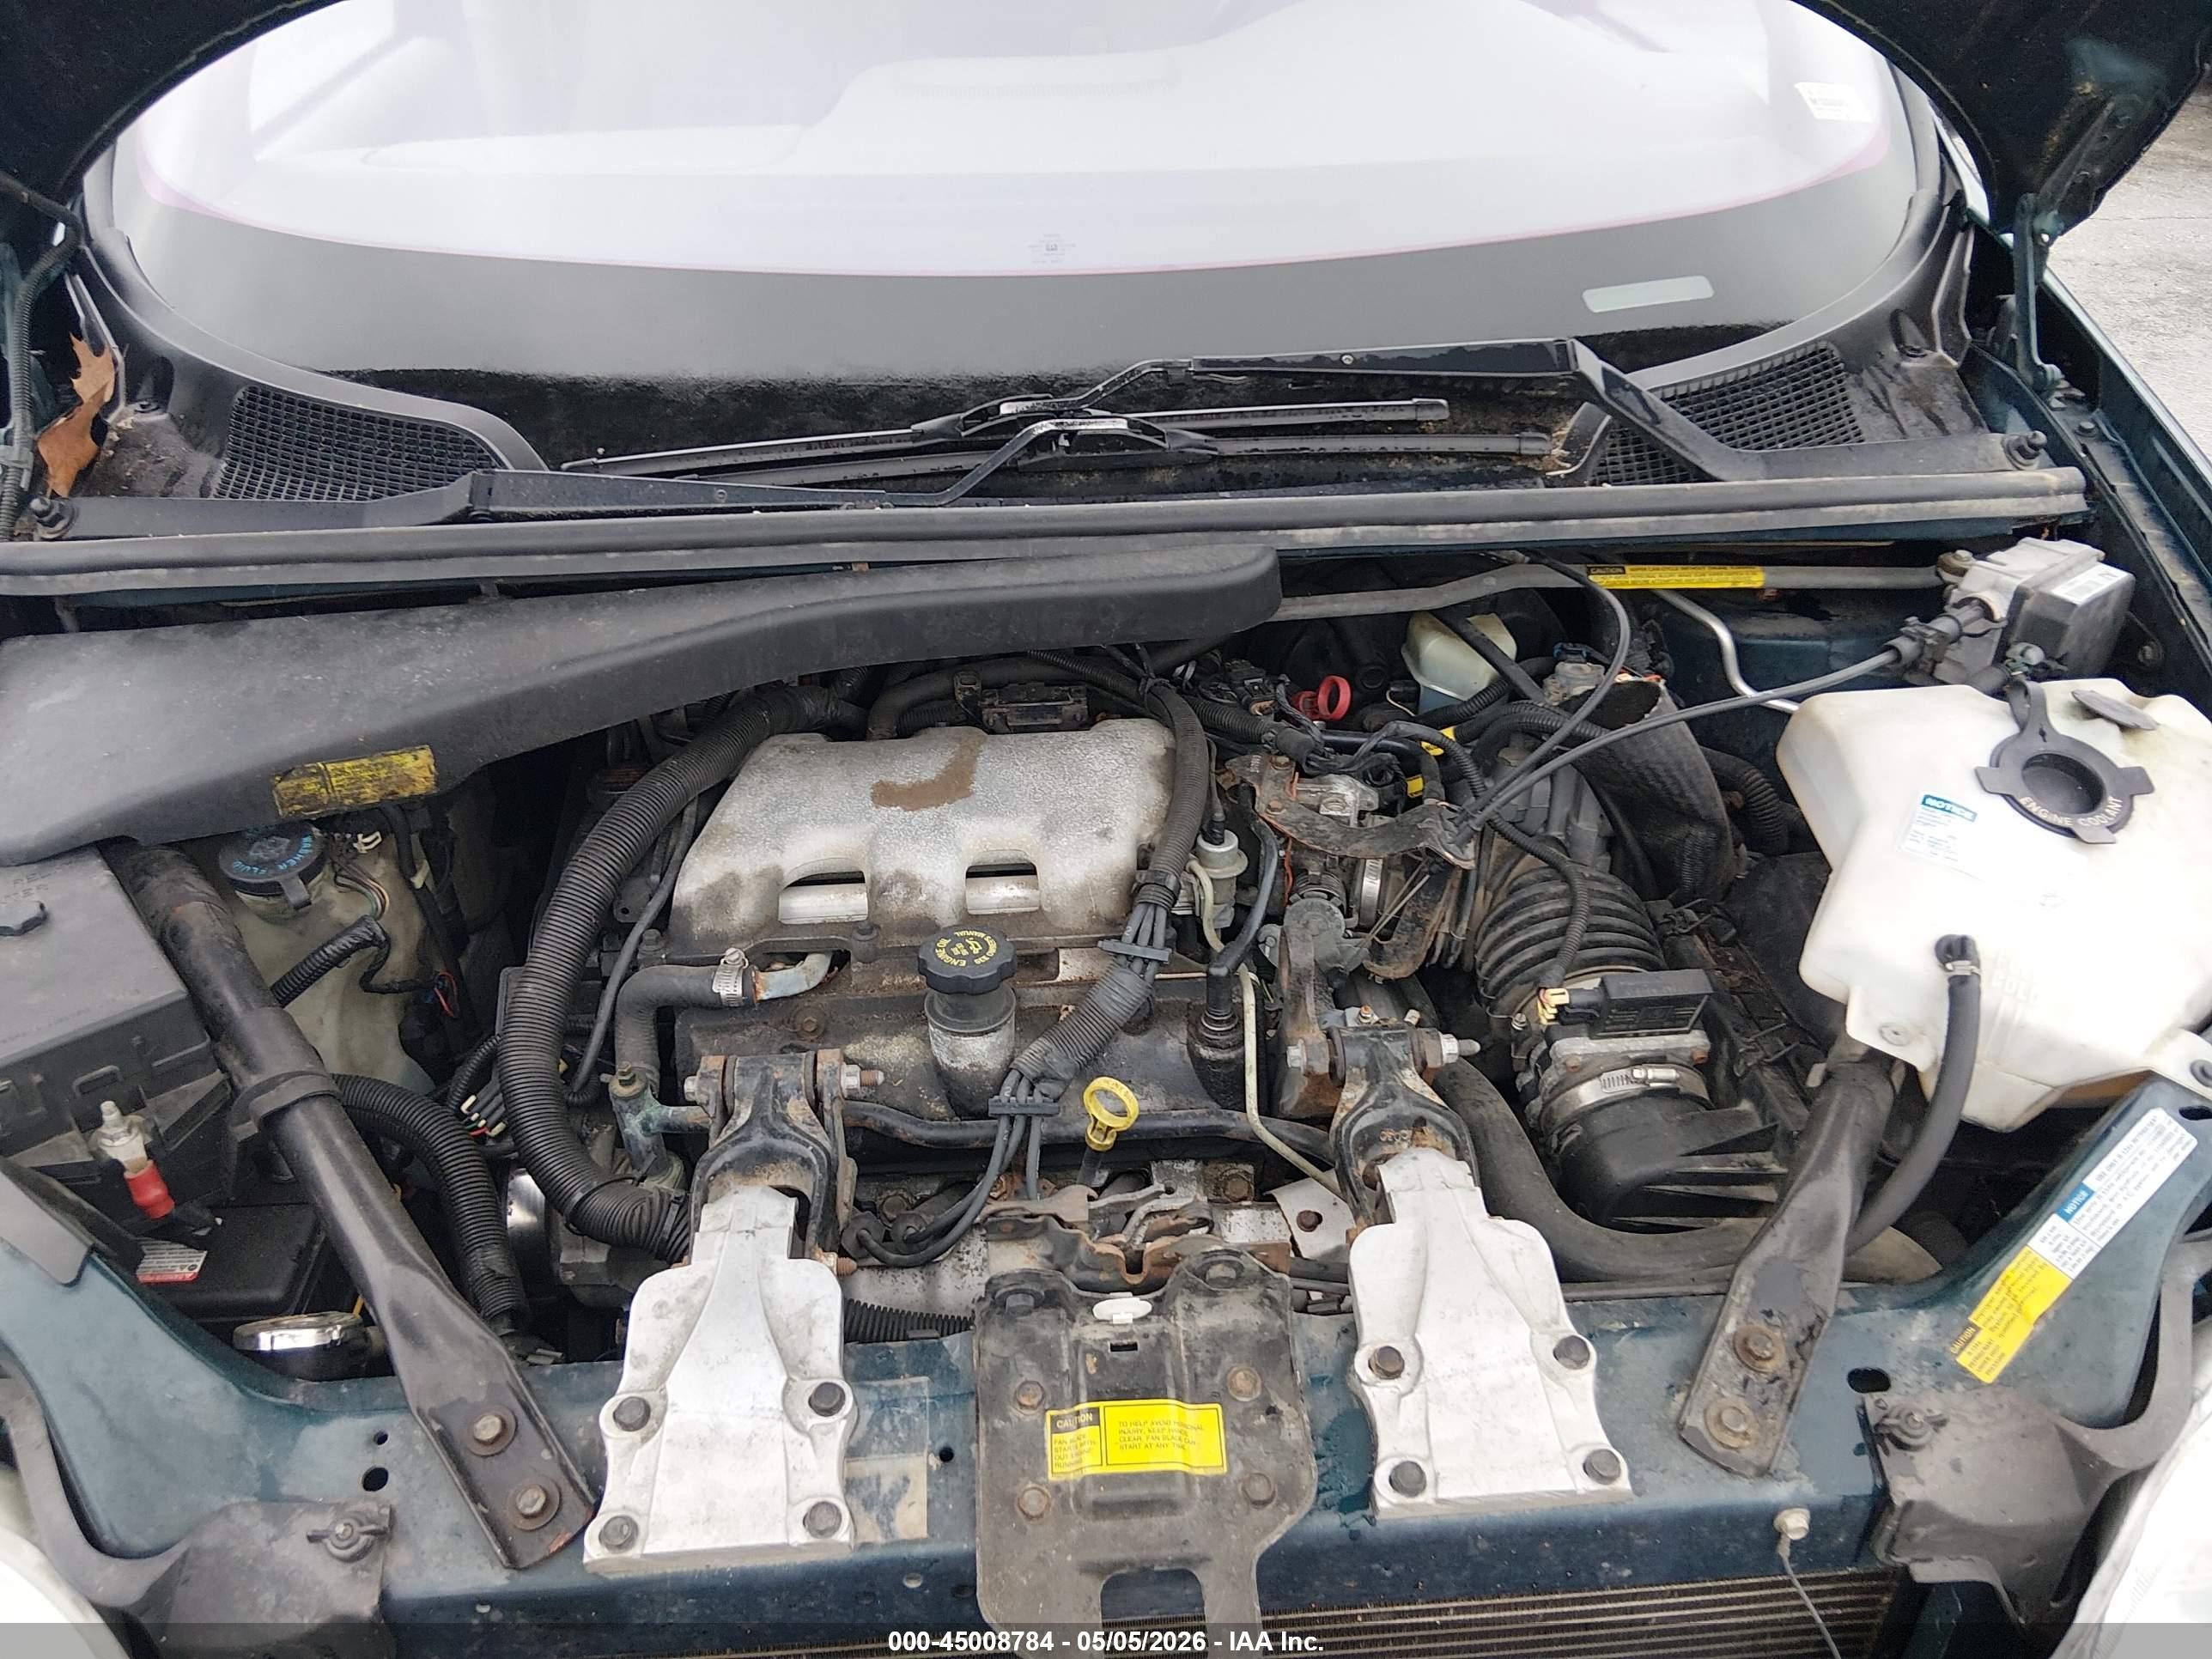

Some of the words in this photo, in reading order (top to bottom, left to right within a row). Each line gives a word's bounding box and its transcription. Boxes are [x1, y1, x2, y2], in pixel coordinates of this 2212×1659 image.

[2019, 797, 2074, 825] ENGINE
[2078, 796, 2124, 826] COOLANT
[233, 860, 268, 875] FLUID
[936, 938, 951, 948] OIL
[934, 948, 967, 967] ENGINE
[2063, 1188, 2091, 1217] NOTICE
[1948, 1325, 1977, 1356] CAUTION
[1056, 1413, 1093, 1429] CAUTION
